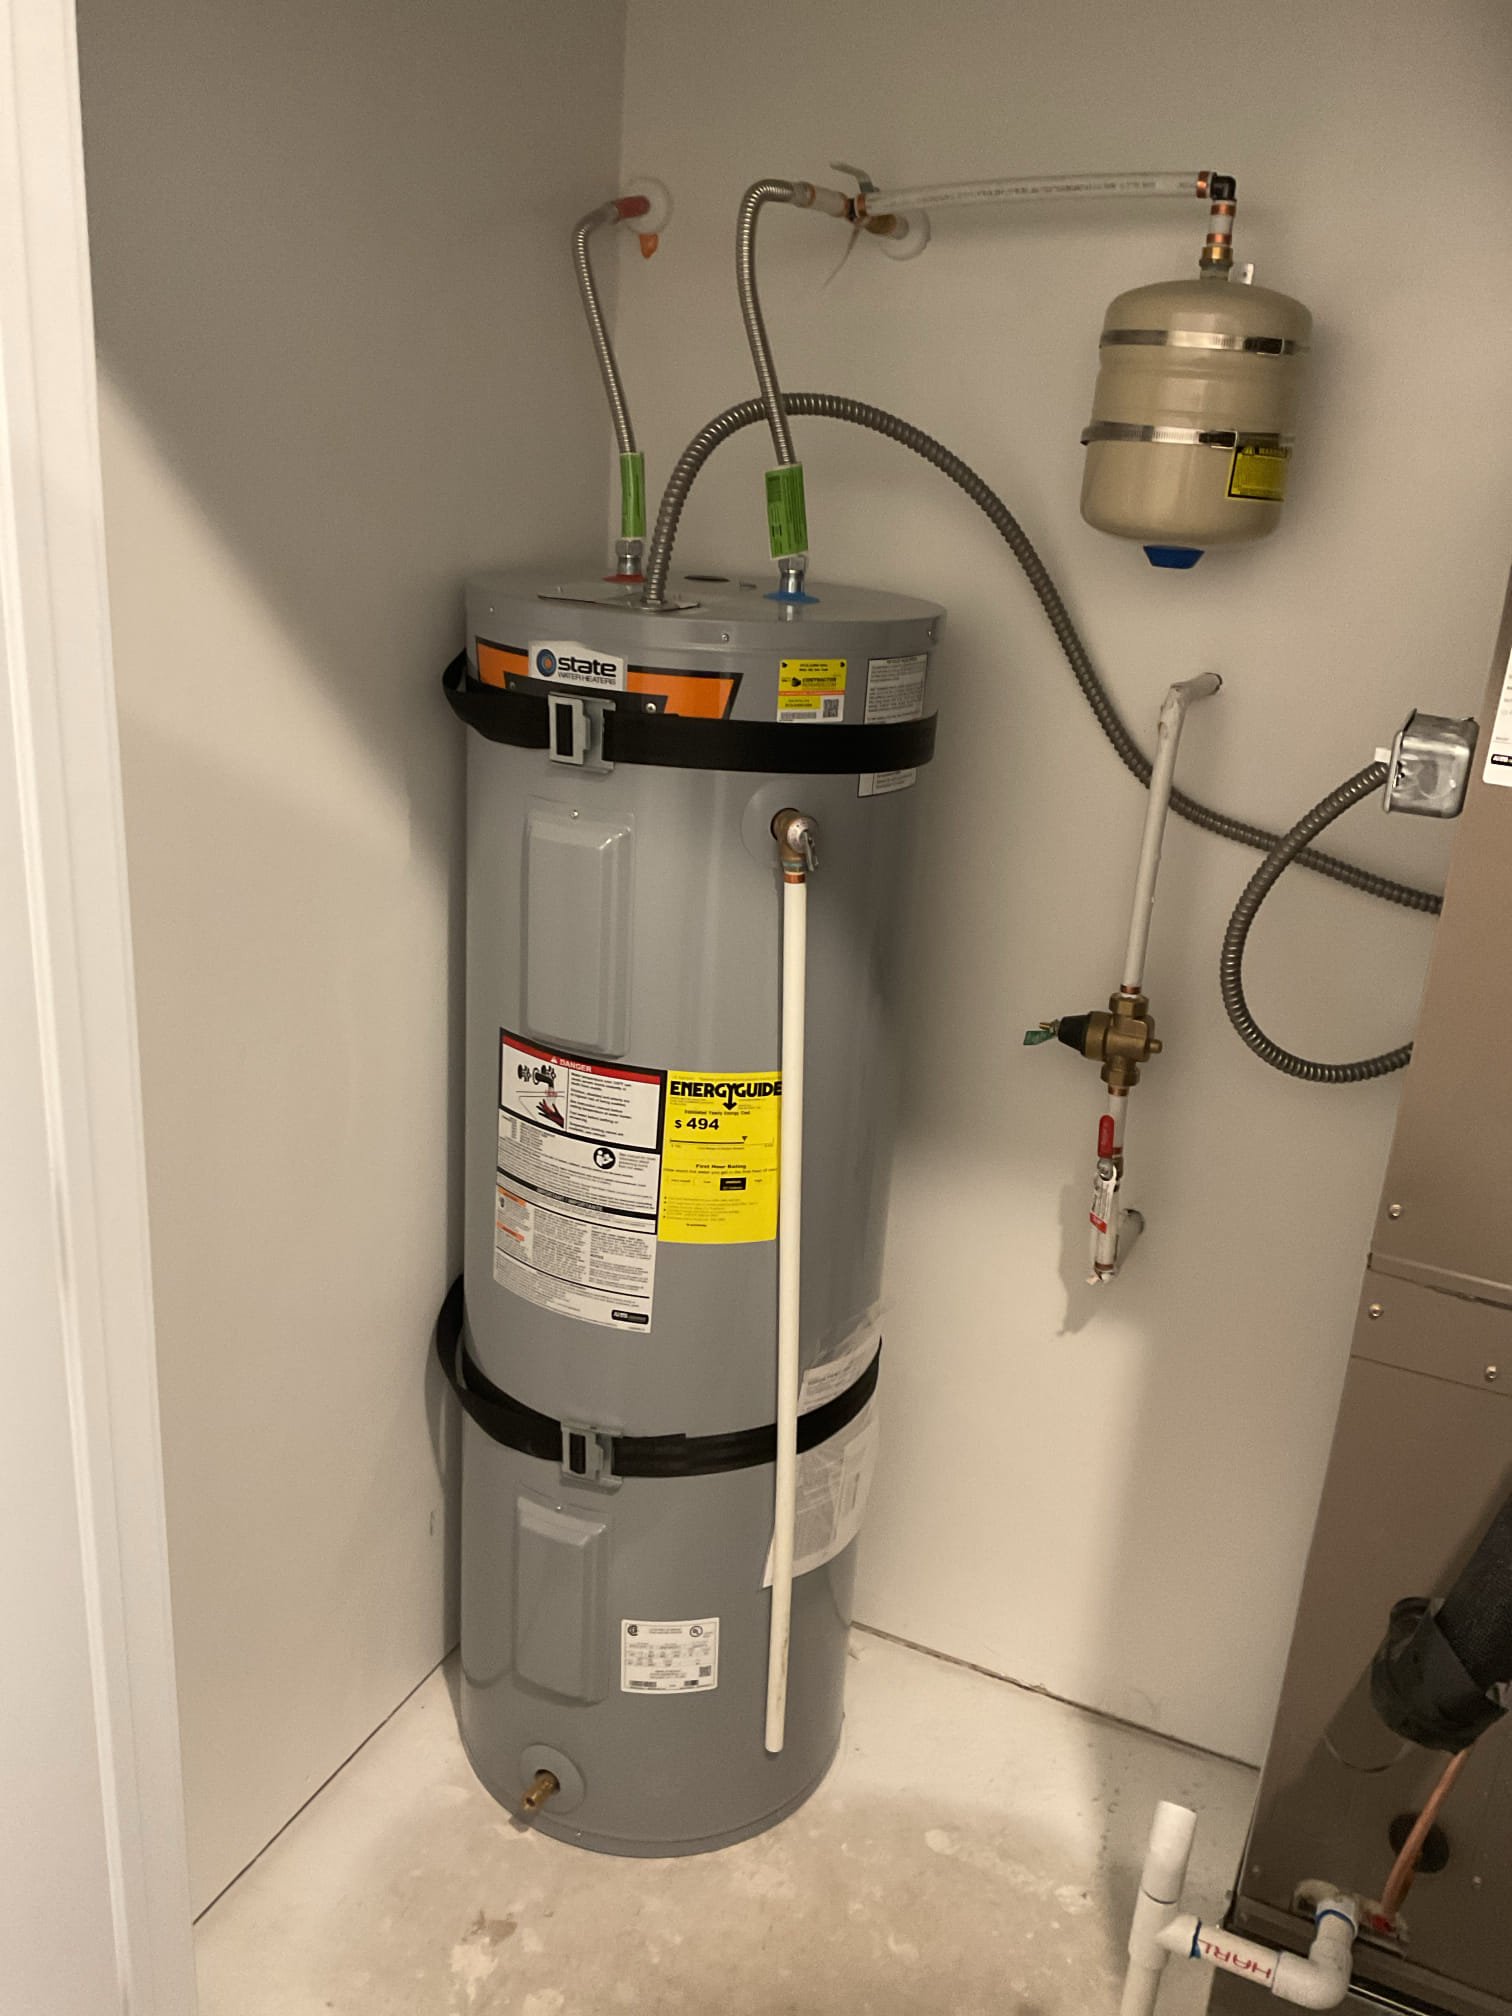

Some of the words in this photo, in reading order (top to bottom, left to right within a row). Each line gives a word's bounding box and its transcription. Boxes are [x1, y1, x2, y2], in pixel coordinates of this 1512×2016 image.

[558, 656, 617, 678] state
[558, 671, 582, 682] WATER
[582, 675, 616, 686] HEATERS
[560, 1058, 592, 1073] DANGER
[670, 1080, 782, 1105] ENERGYGUIDE
[686, 1117, 720, 1130] 494
